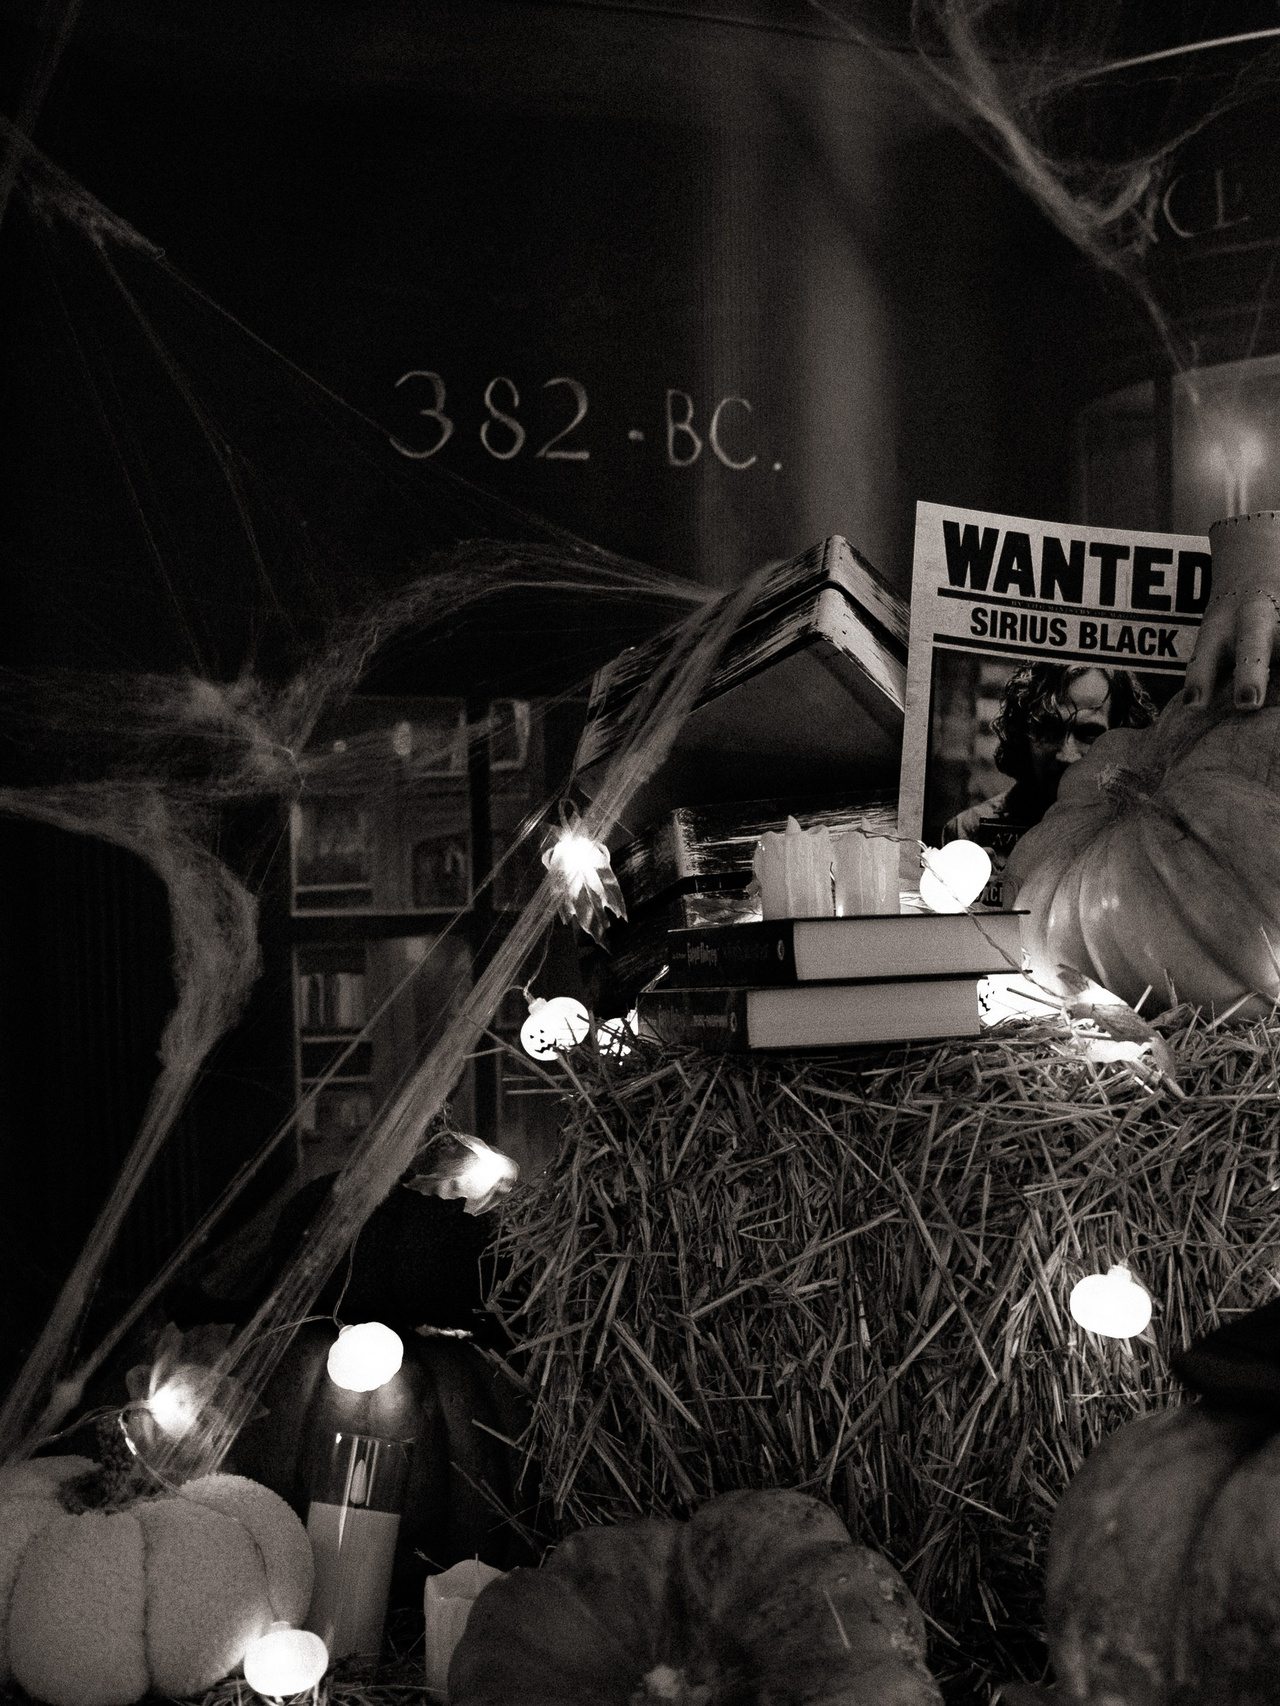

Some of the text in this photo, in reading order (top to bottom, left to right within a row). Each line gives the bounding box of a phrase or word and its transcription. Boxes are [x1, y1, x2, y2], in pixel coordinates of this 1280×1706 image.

[390, 369, 591, 459] 382
[942, 520, 1212, 614] WANTED
[969, 606, 1180, 658] SIRIUS BLACK
